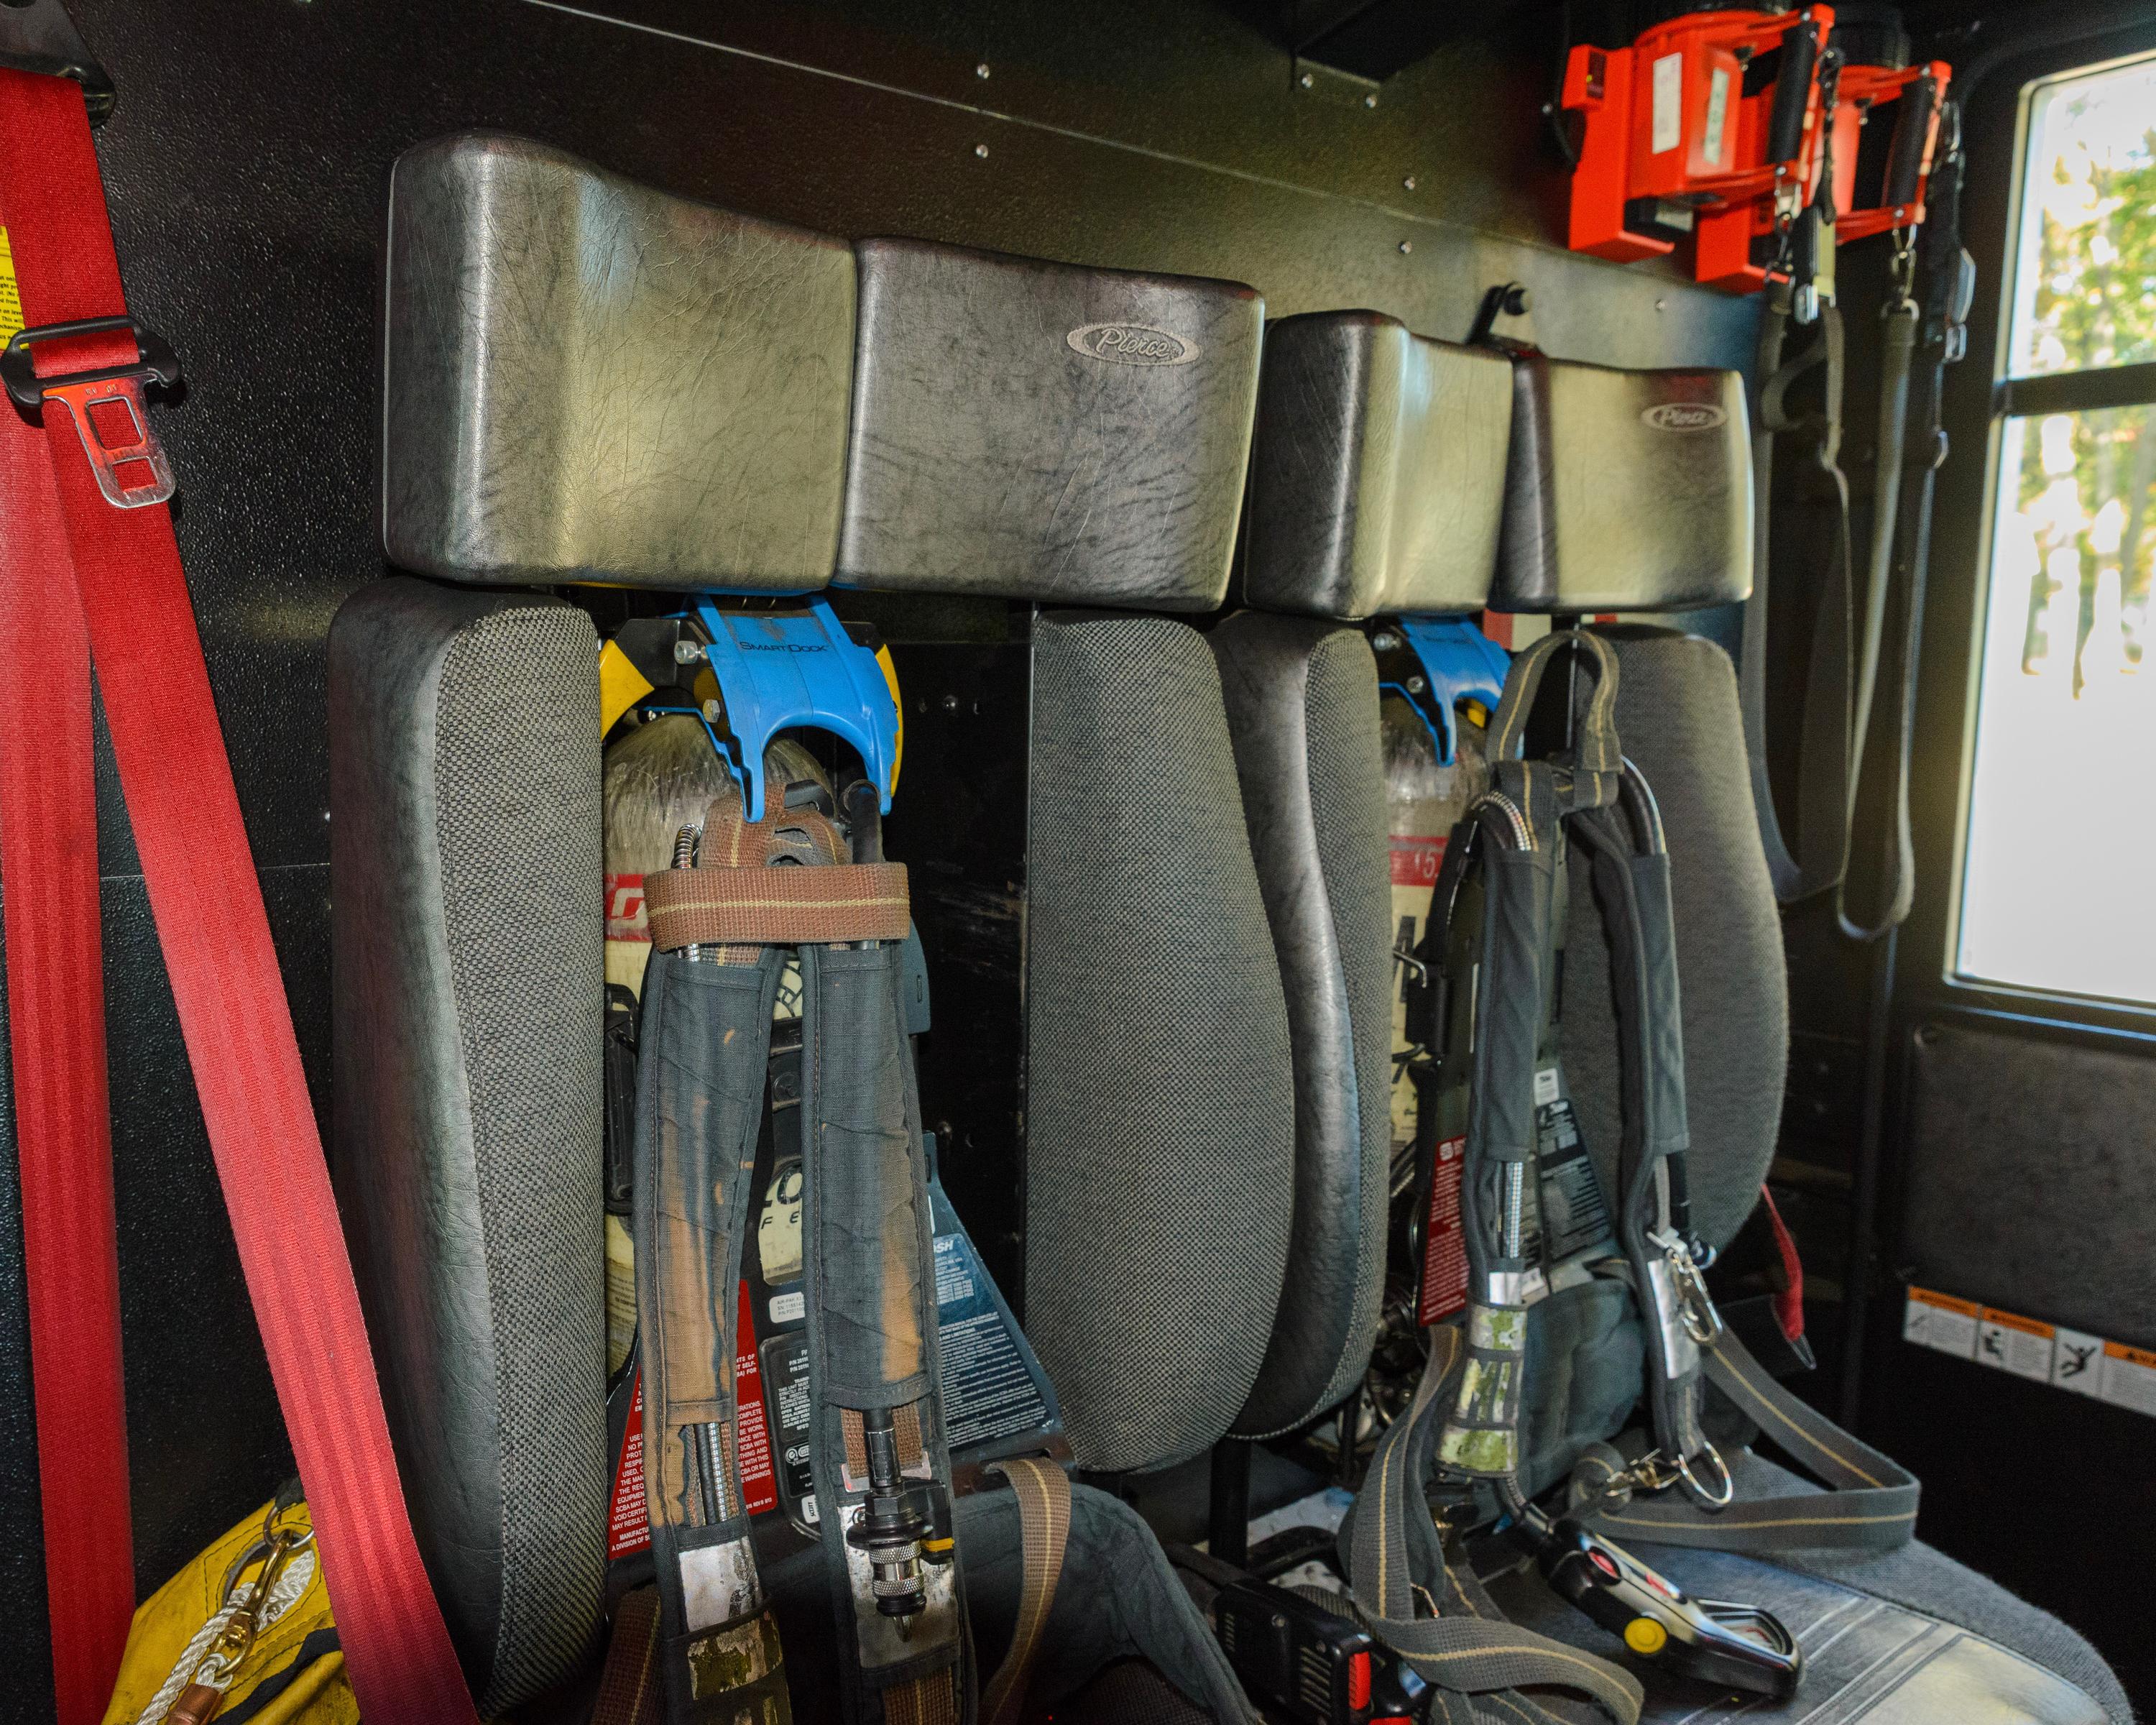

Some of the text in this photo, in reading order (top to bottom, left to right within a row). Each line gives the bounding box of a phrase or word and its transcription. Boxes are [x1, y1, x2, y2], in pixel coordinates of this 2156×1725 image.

[1095, 326, 1171, 358] Pierce
[740, 1416, 764, 1427] PROVIDE
[630, 1434, 640, 1443] USE
[752, 1431, 765, 1440] WITH
[620, 1478, 632, 1486] THE
[740, 1442, 754, 1451] SCBA
[754, 1438, 767, 1448] WITH
[745, 1456, 757, 1466] WITH
[757, 1453, 769, 1463] THIS
[615, 1502, 630, 1513] SCBA
[630, 1500, 641, 1509] MAY
[750, 1464, 759, 1473] OR
[759, 1461, 770, 1471] MAY
[619, 1486, 630, 1495] THE
[613, 1512, 627, 1522] VOID
[745, 1469, 771, 1482] WARNINGS
[612, 1515, 644, 1532] MAY RESULT
[616, 1539, 637, 1551] DIVISION
